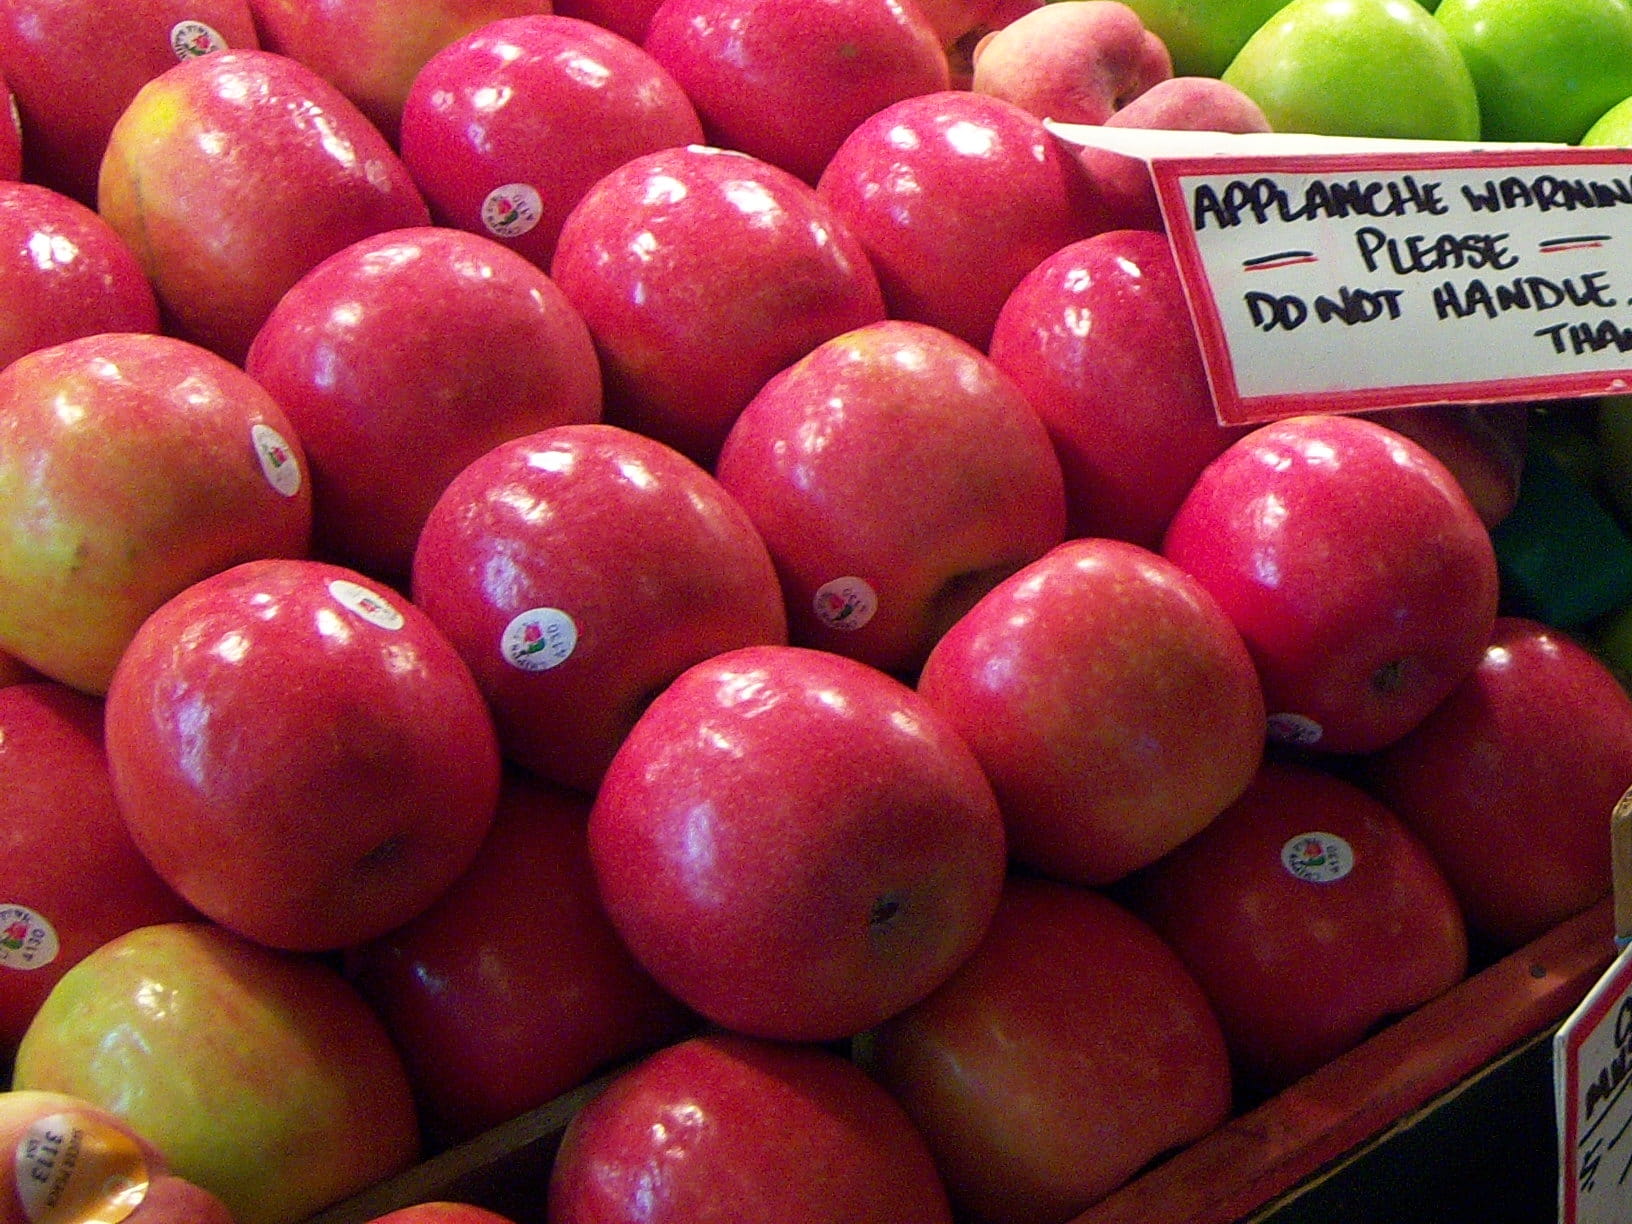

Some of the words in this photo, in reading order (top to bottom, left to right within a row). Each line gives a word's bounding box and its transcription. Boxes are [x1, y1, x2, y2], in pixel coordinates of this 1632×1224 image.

[1194, 175, 1450, 231] APPLANCHE
[1356, 226, 1519, 275] PLEASE
[1245, 290, 1306, 332] DO
[1315, 287, 1405, 326] NOT
[32, 1130, 62, 1184] 3113
